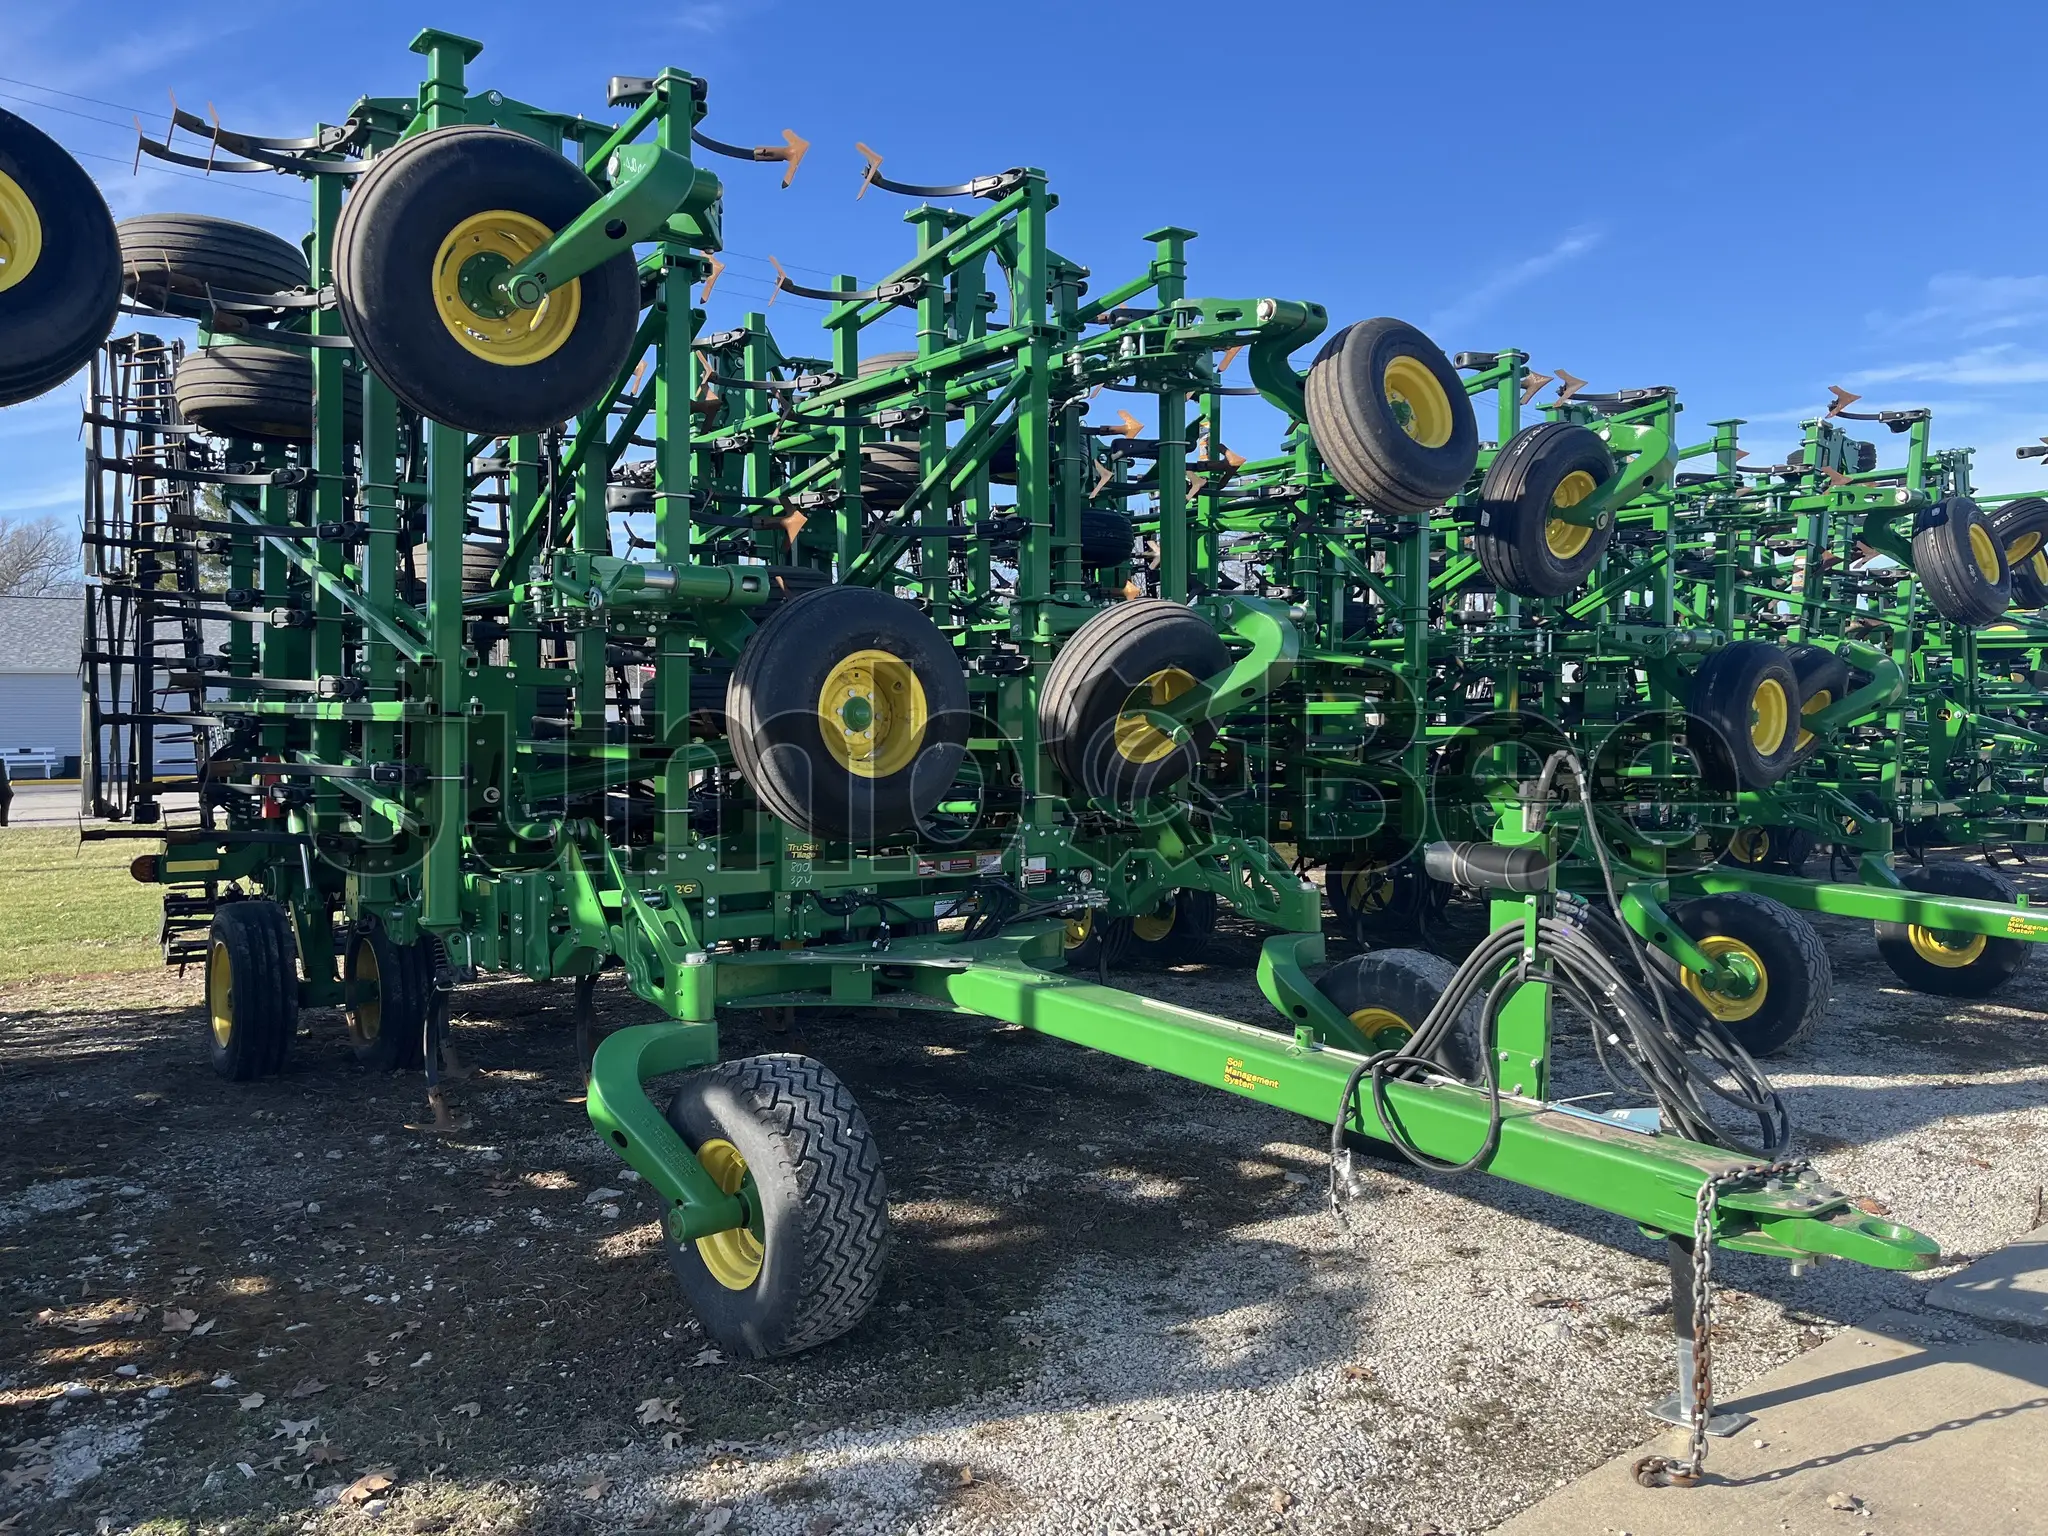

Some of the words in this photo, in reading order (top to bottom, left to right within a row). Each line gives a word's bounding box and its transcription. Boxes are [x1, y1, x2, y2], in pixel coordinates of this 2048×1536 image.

[788, 843, 819, 851] TruSet
[791, 851, 816, 859] Tillage
[1227, 1057, 1244, 1068] Soil
[1224, 1074, 1255, 1090] System
[1225, 1065, 1279, 1089] Management
